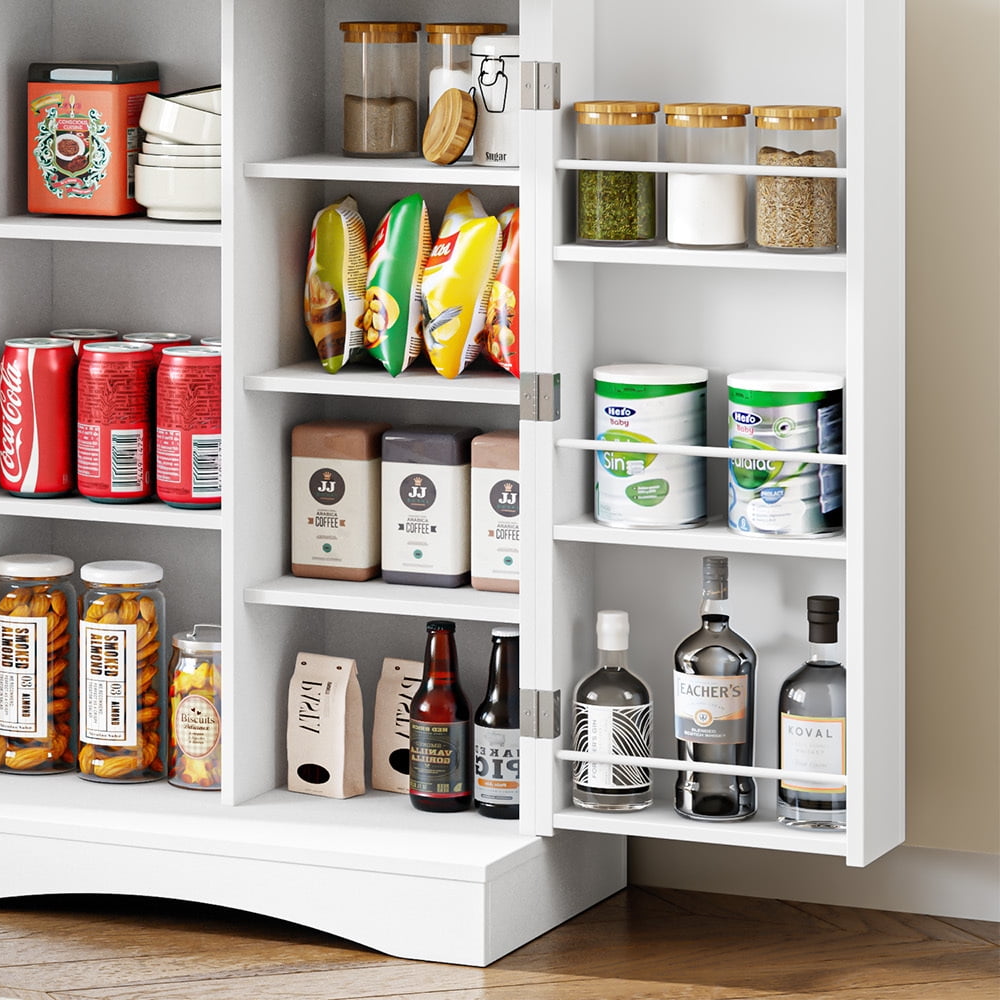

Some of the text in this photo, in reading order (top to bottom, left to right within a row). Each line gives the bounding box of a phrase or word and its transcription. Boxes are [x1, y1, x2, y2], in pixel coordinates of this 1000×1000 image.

[485, 151, 507, 162] Sugar
[608, 407, 631, 417] Hero
[734, 412, 756, 424] Hero
[610, 418, 630, 427] Baby
[736, 424, 755, 435] Baby
[317, 481, 336, 493] JJ
[408, 486, 427, 498] JJ
[498, 492, 518, 505] JJ
[315, 516, 339, 529] COFFEE
[405, 522, 430, 534] COFFEE
[496, 528, 520, 541] COFFEE
[1, 625, 13, 668] ALMOND
[15, 627, 29, 669] SMOKED
[90, 633, 103, 675] ALMOND
[104, 634, 119, 677] SMOKED
[22, 693, 31, 717] ALMOND
[111, 701, 120, 725] ALMOND
[181, 713, 216, 724] Biscuits
[788, 725, 833, 738] KOVAL
